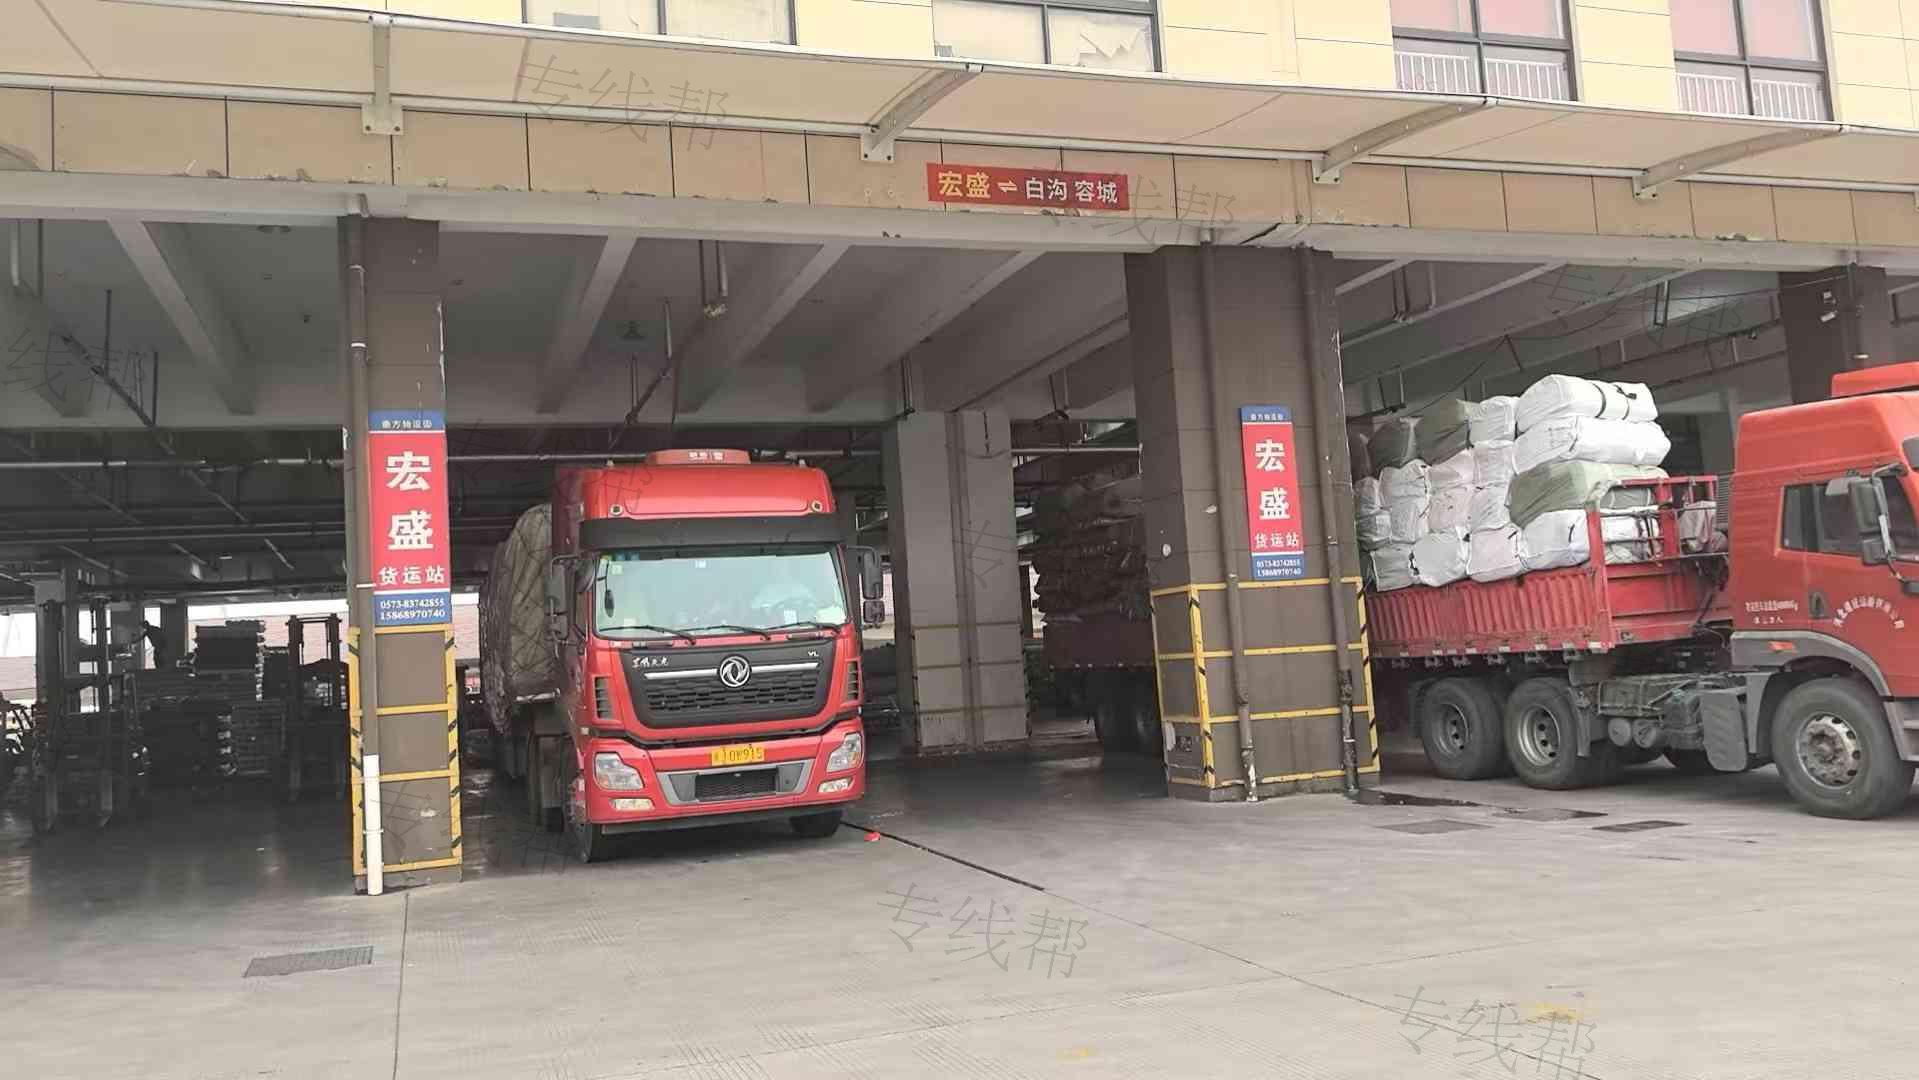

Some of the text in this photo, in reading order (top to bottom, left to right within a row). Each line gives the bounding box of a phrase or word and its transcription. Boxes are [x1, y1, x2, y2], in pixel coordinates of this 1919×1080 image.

[937, 170, 1119, 204] 宏盛 白沟 容城
[1255, 439, 1290, 521] 宏盛
[386, 450, 434, 550] 宏盛
[1254, 531, 1300, 549] 货运站
[378, 565, 446, 586] 货运站
